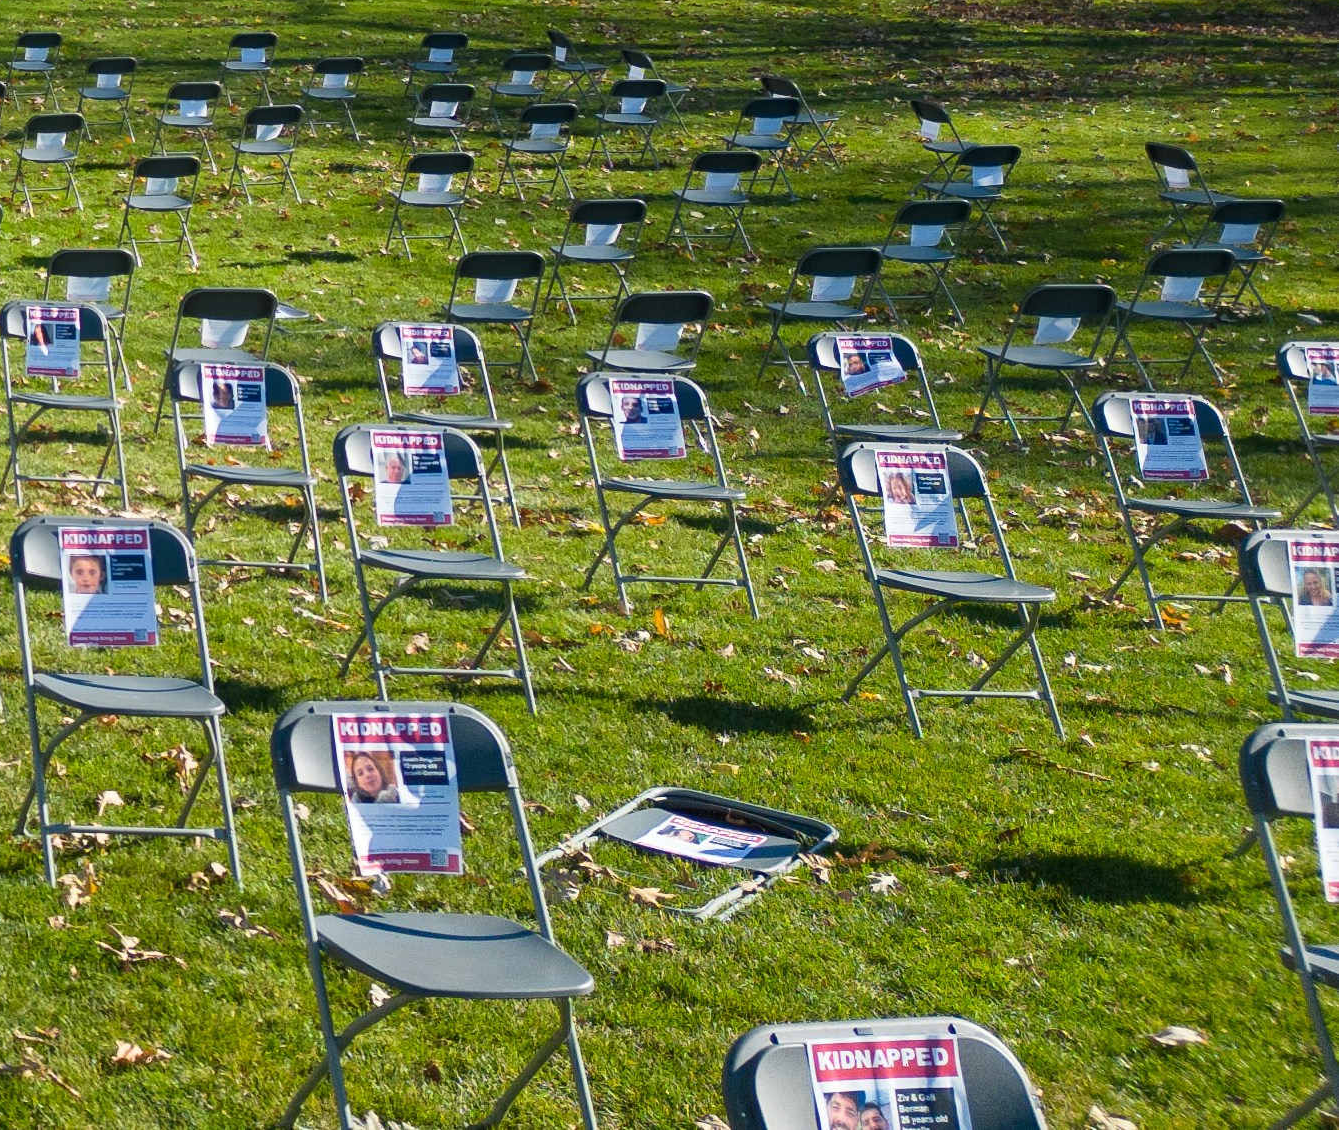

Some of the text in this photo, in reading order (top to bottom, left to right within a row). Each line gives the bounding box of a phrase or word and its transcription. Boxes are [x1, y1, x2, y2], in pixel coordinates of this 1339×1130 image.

[205, 369, 260, 378] KIDNAPPED
[613, 382, 669, 392] KIDNAPPED
[1134, 402, 1190, 411] KIDNAPPED
[374, 435, 437, 446] KIDNAPPED
[880, 454, 942, 465] KIDNAPPED
[64, 534, 143, 544] KIDNAPPED
[340, 722, 442, 736] KIDNAPPED
[816, 1047, 949, 1071] KIDNAPPED
[935, 1115, 948, 1123] old
